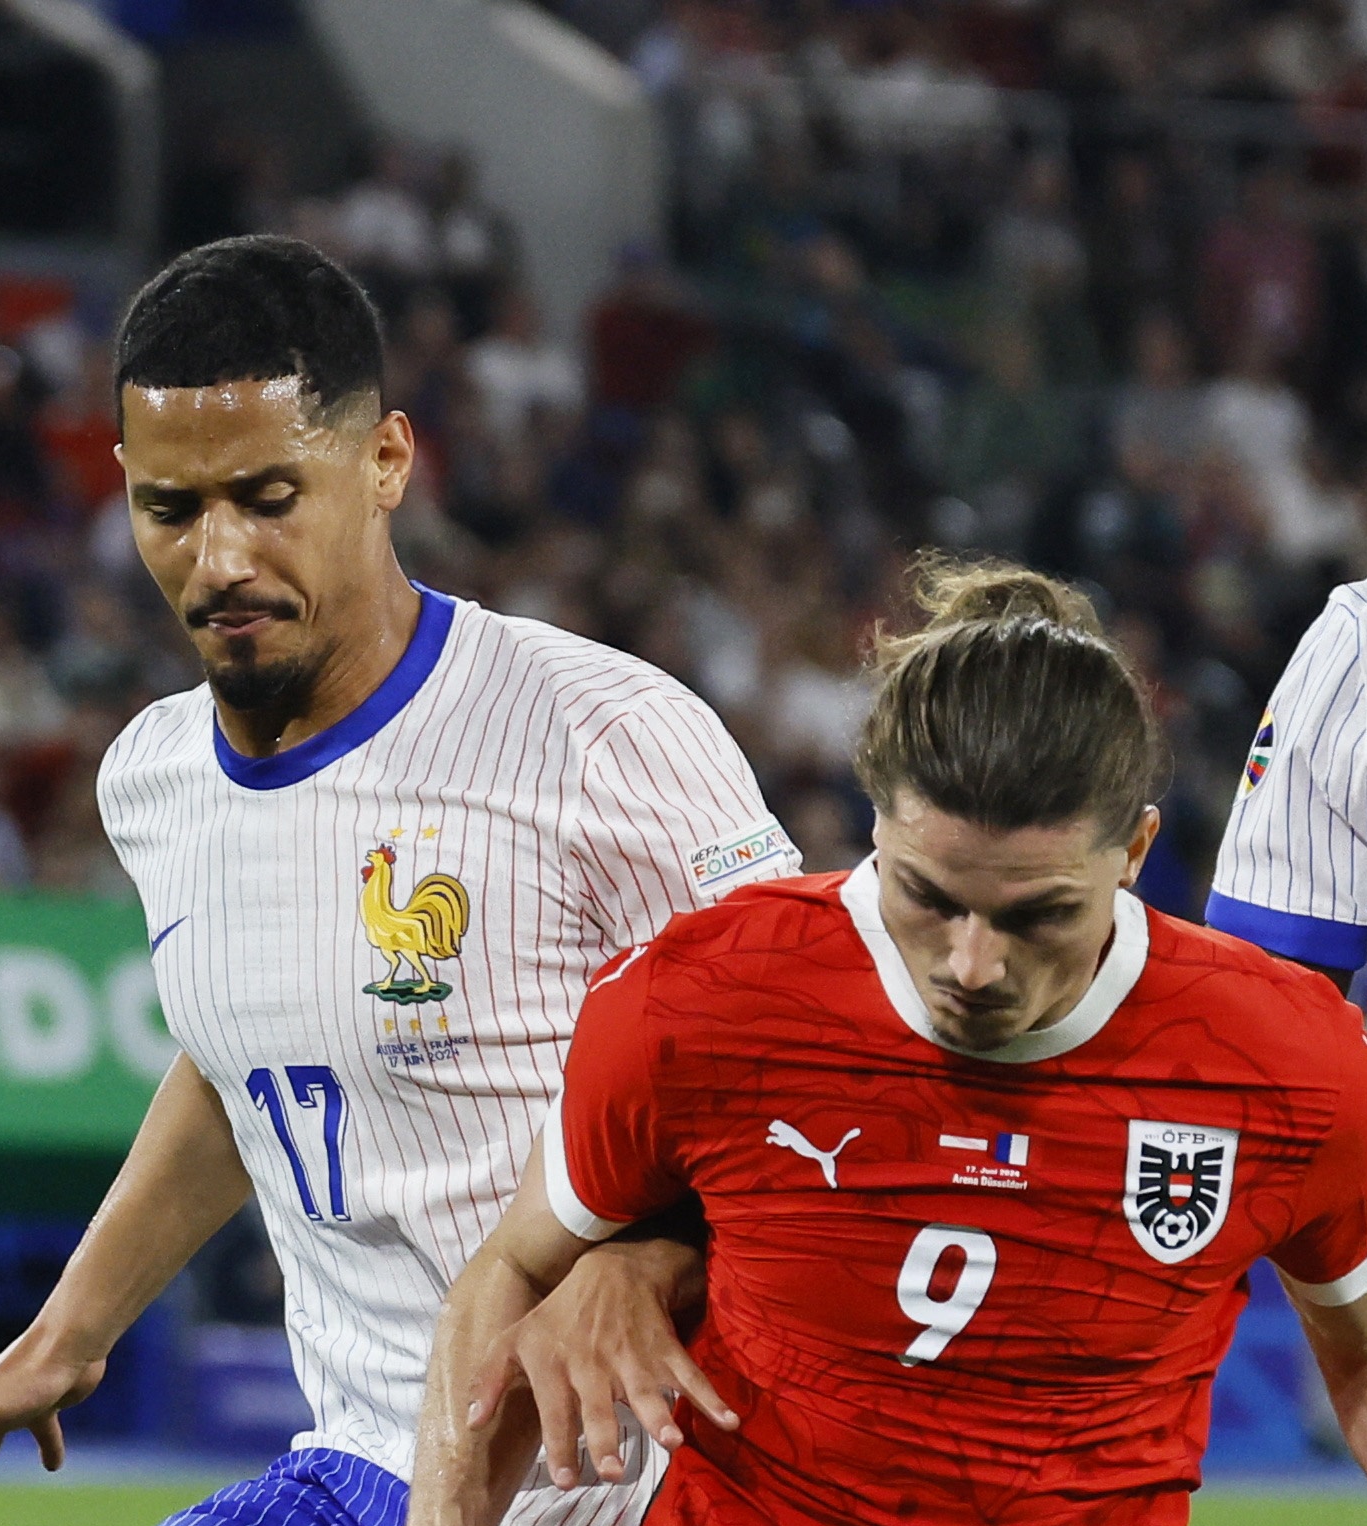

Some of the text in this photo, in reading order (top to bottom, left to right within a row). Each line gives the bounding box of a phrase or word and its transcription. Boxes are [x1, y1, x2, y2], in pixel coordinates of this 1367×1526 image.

[690, 845, 721, 864] UEFA
[429, 1036, 469, 1050] FRANCE
[428, 1047, 461, 1063] 2024
[246, 1065, 352, 1222] 17
[1161, 1129, 1206, 1145] ÖFB
[952, 1173, 1028, 1190] Arena Düsseldorf
[897, 1222, 997, 1368] 9
